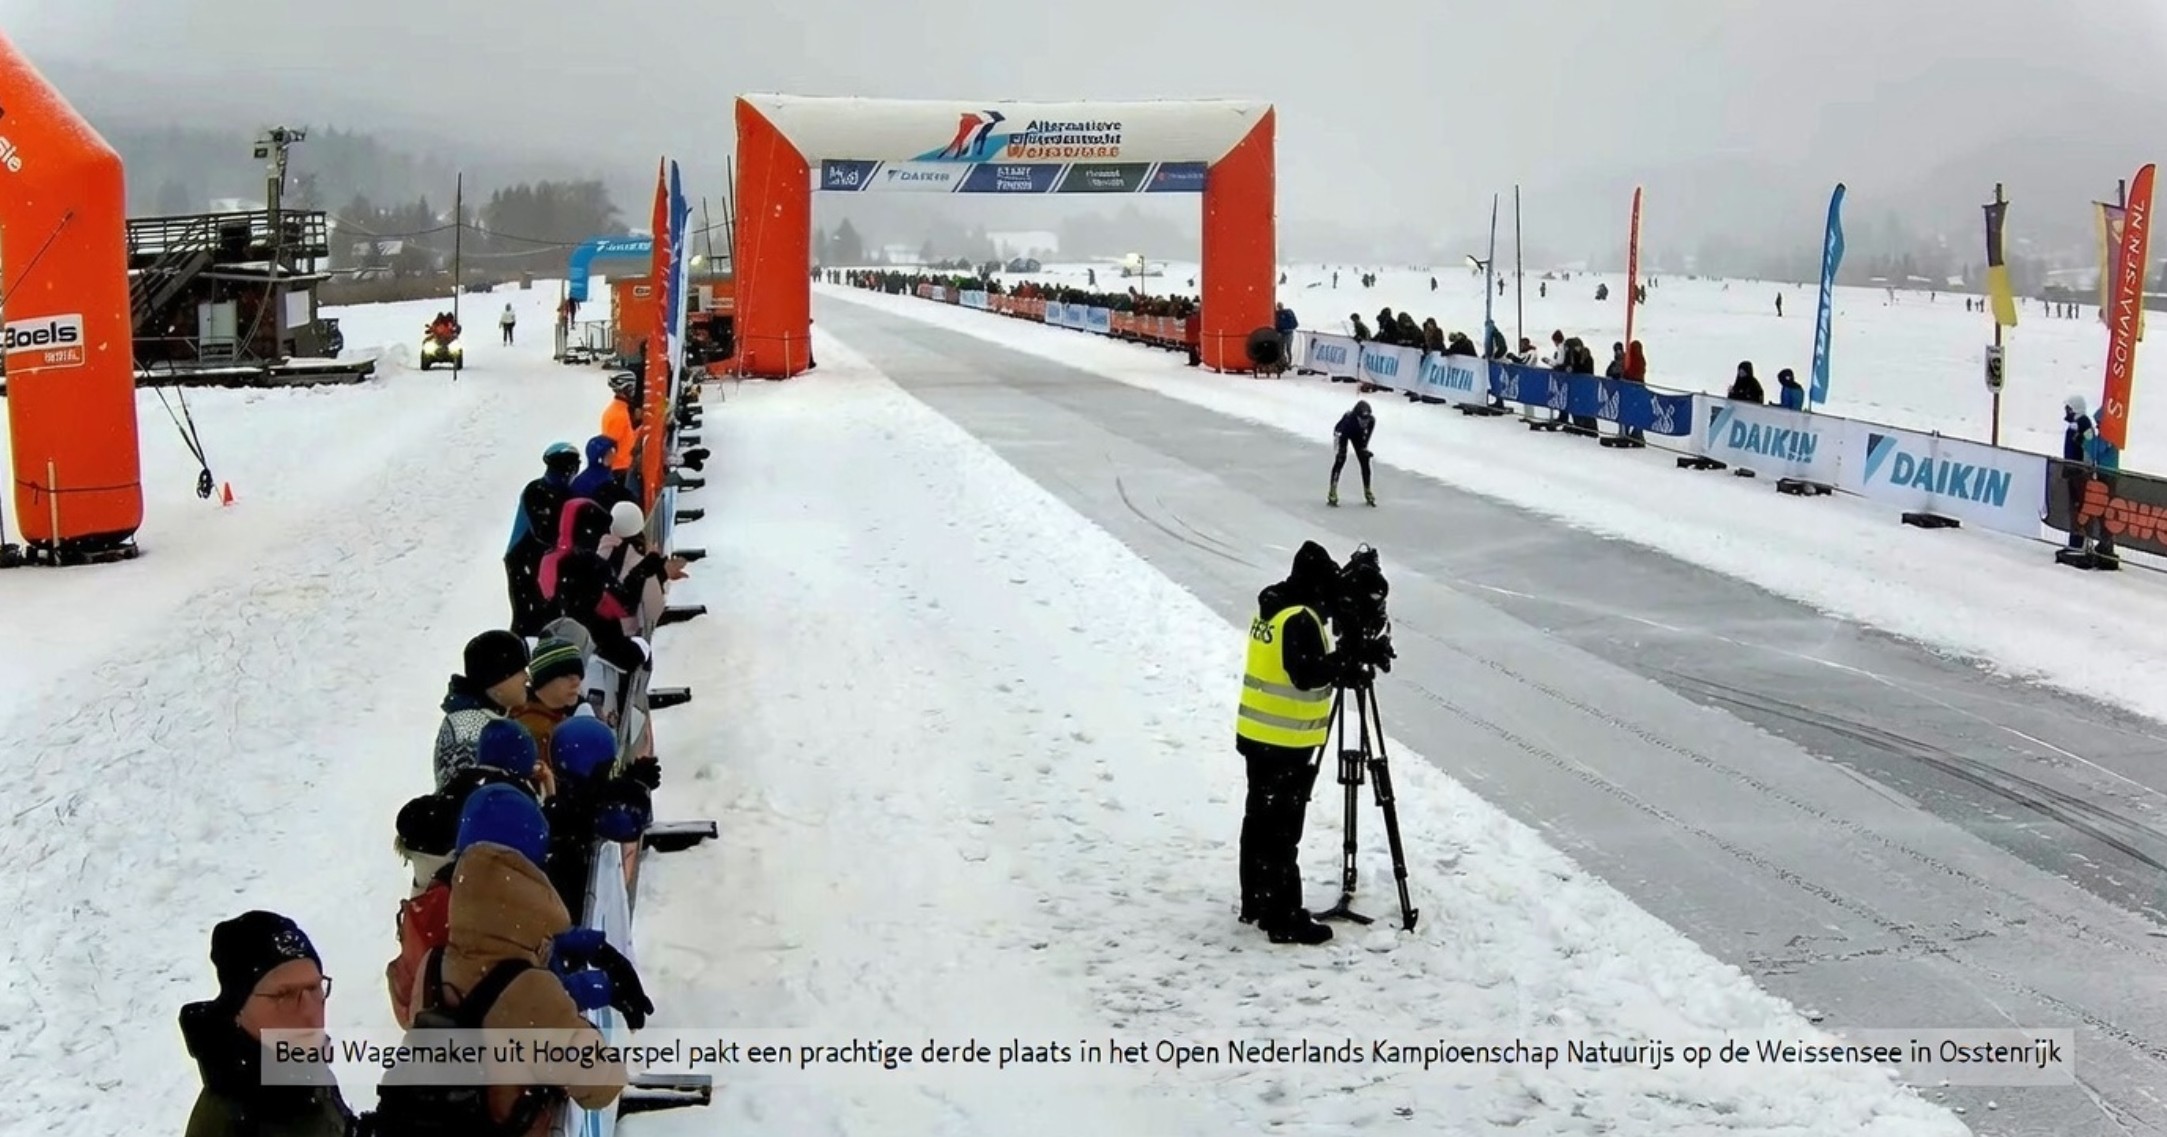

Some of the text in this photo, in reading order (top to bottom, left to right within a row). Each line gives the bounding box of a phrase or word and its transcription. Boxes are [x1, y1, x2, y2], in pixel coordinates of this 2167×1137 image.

[5, 321, 78, 349] Boels
[1727, 418, 1818, 462] DAIKIN
[1889, 451, 2012, 507] DAIKIN
